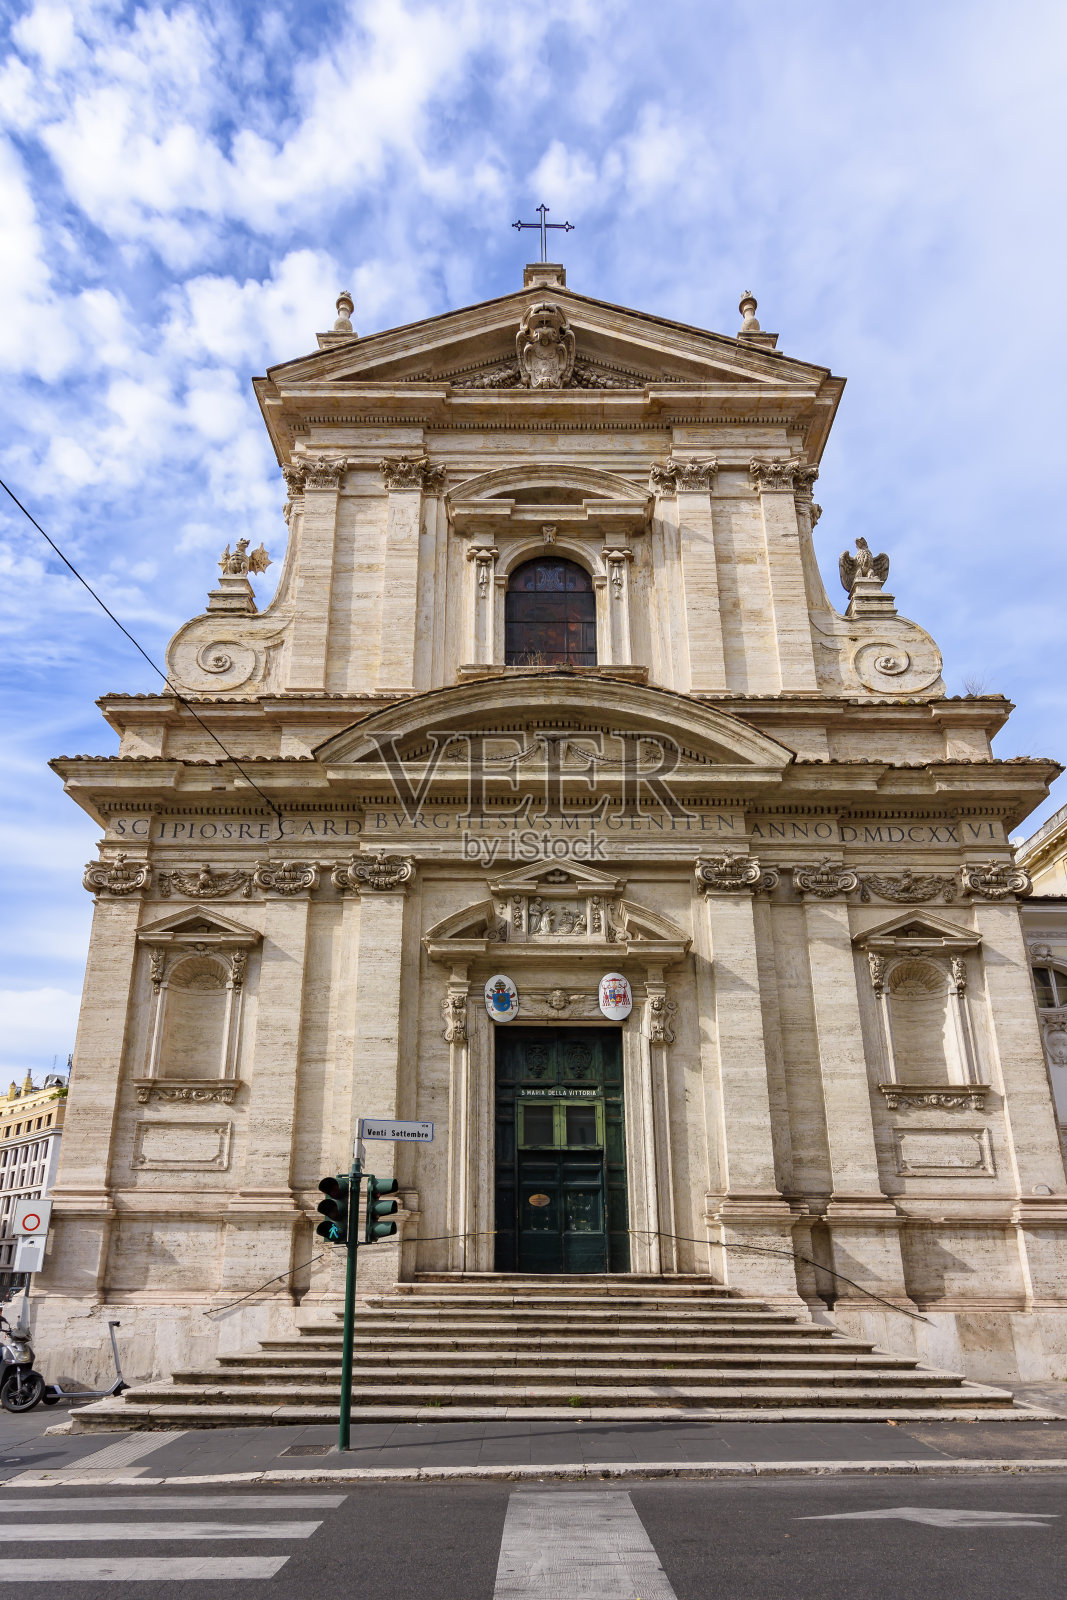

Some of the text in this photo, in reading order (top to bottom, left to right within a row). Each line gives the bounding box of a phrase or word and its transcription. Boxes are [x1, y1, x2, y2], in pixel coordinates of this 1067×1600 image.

[279, 819, 362, 836] CARD
[751, 822, 832, 838] ANNO
[367, 1128, 429, 1138] Venti Settembre
